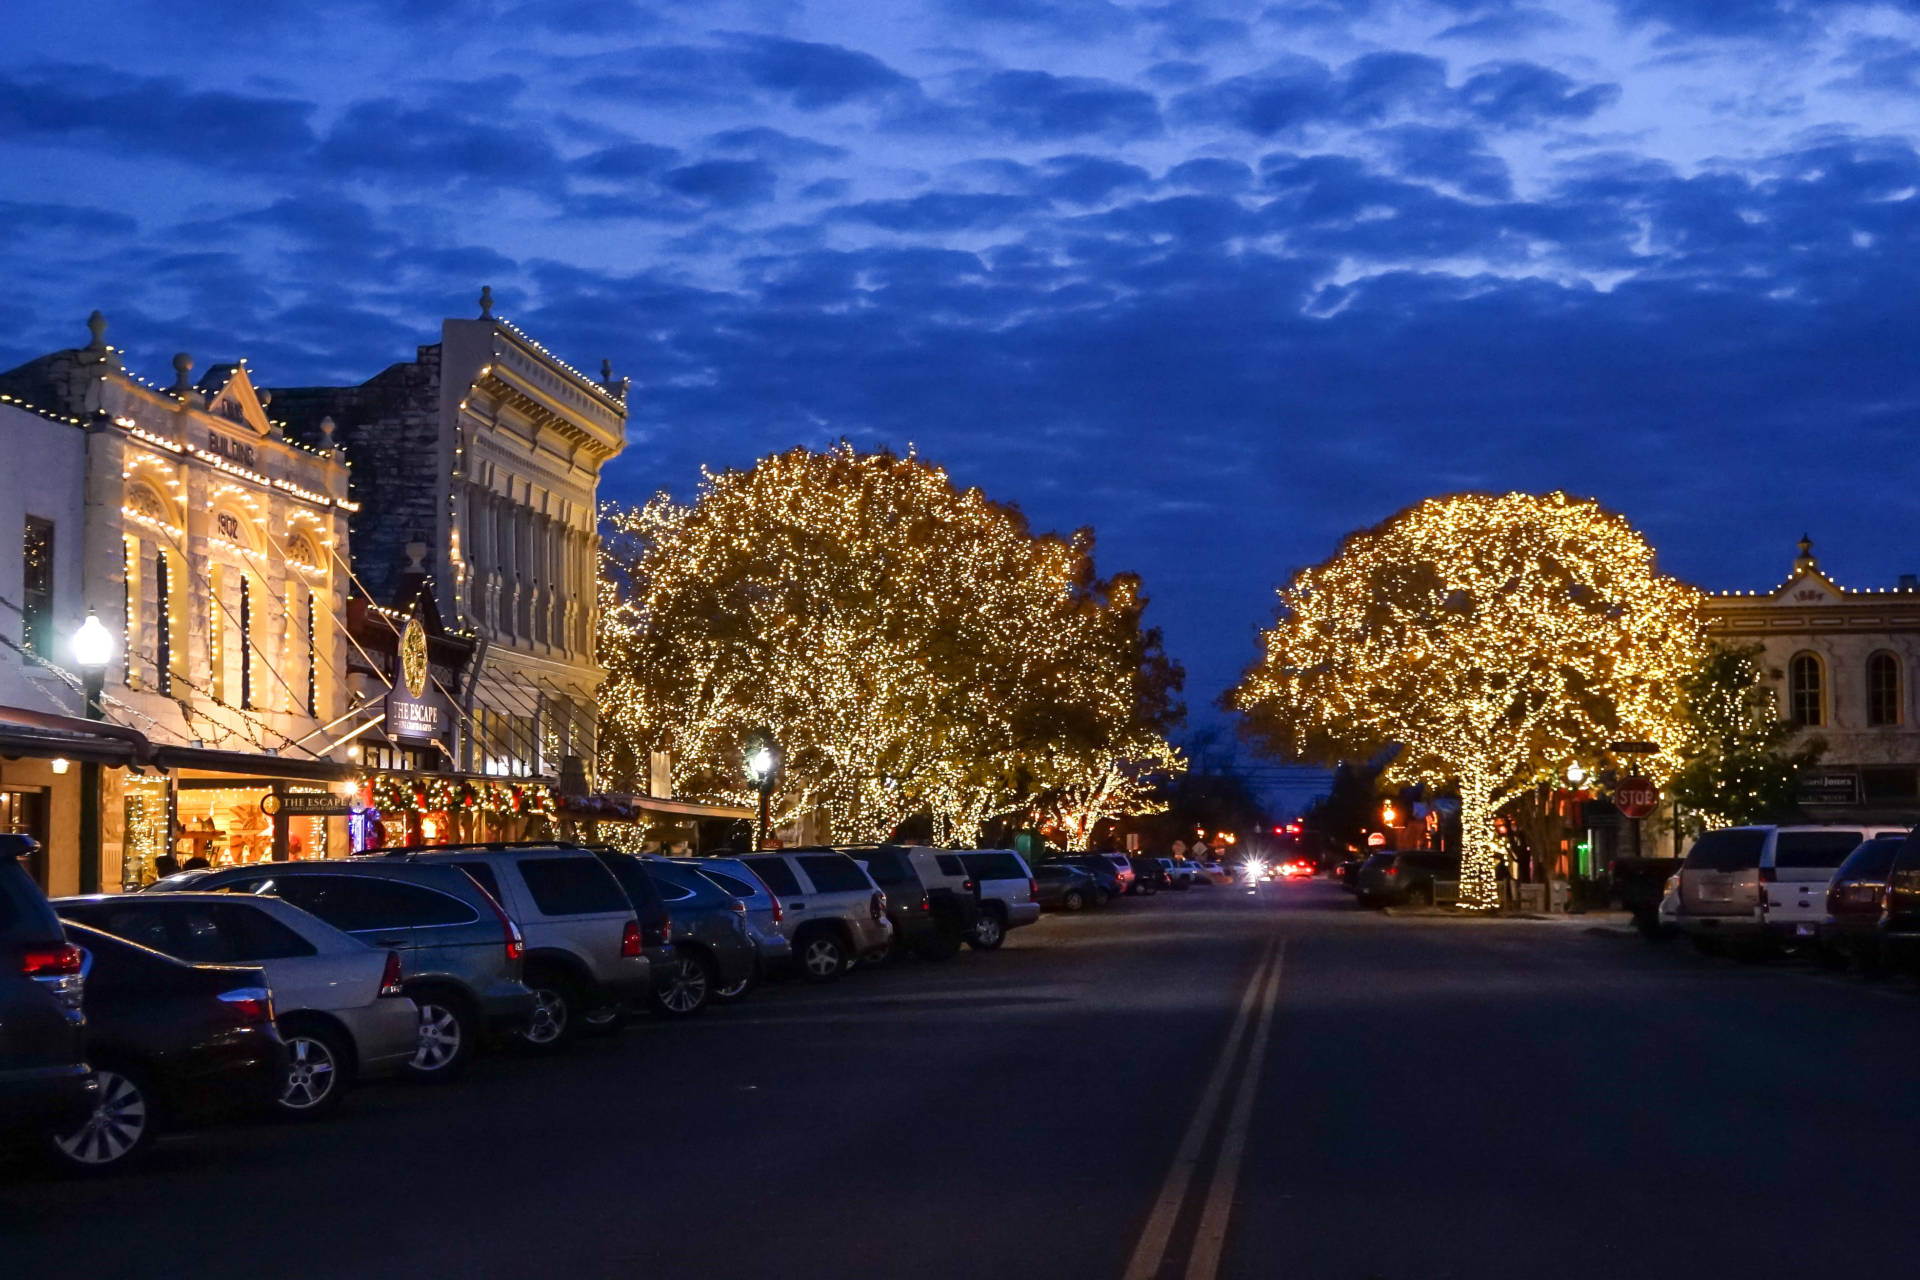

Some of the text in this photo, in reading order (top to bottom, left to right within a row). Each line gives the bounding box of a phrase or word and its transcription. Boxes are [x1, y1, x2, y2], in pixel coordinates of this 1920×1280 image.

[217, 512, 238, 539] 1902
[393, 701, 438, 724] THE ESCAPE
[284, 797, 347, 808] THE ESCAPE
[1619, 789, 1655, 806] STOP
